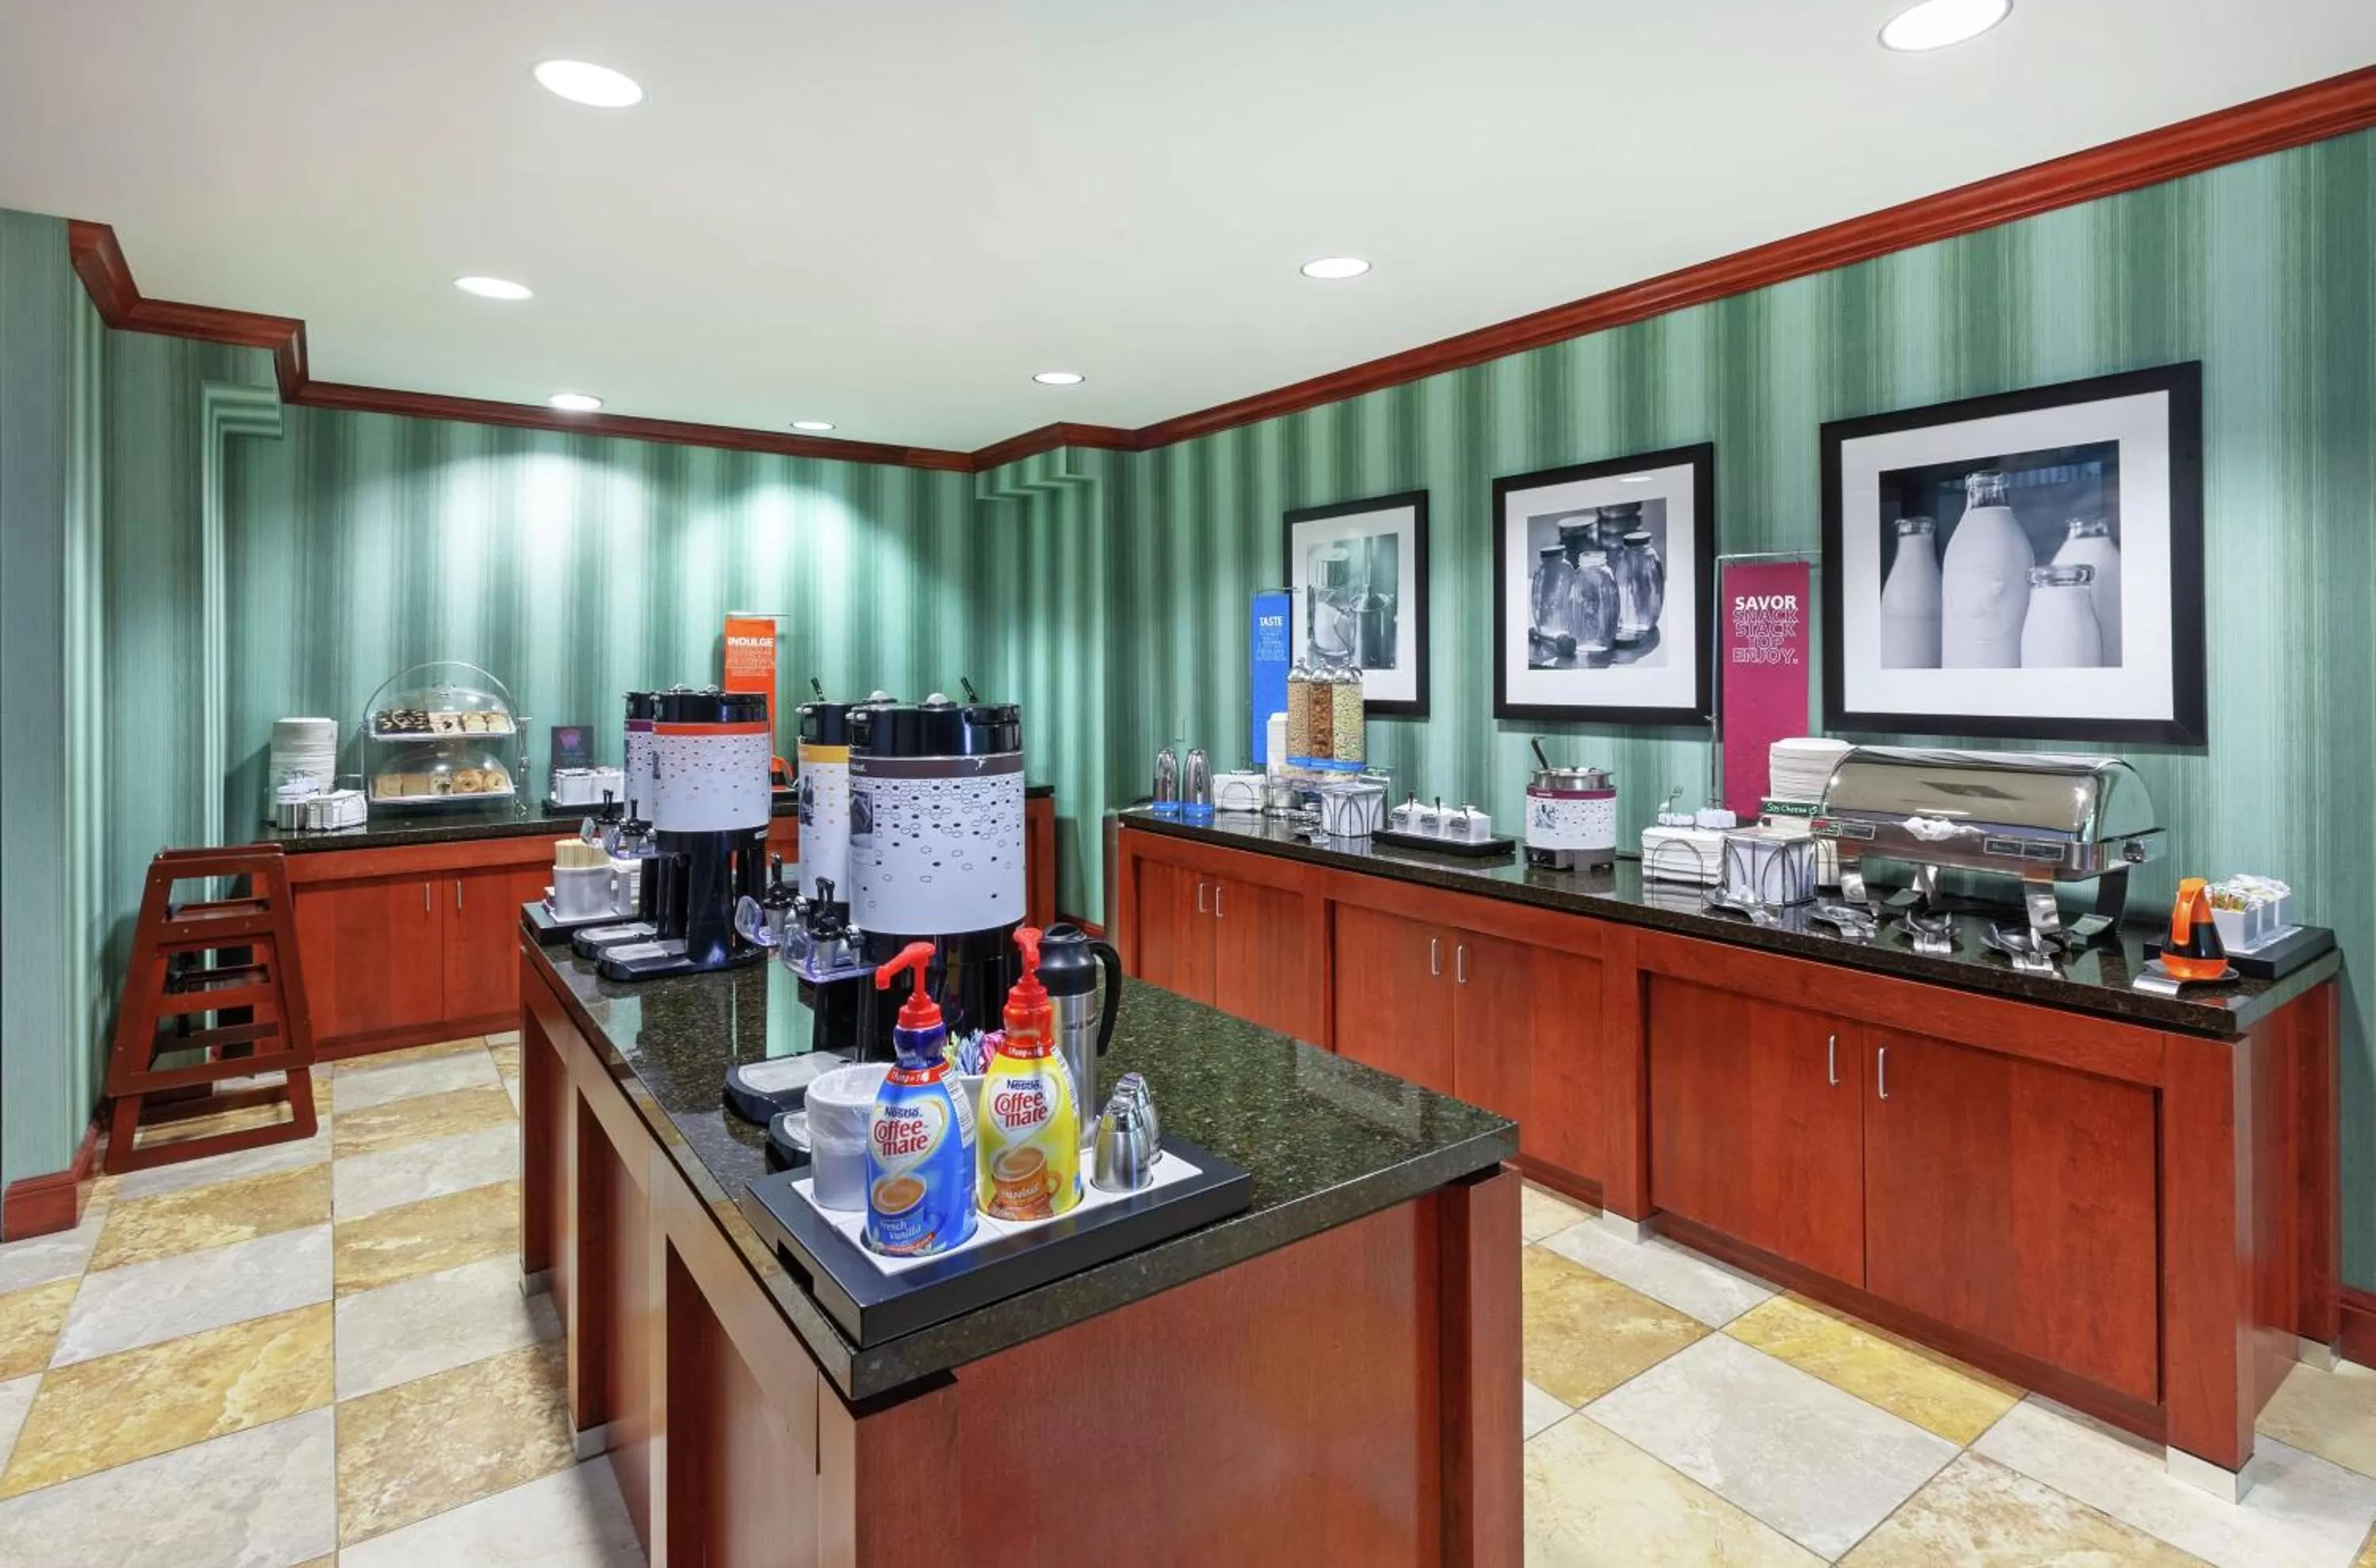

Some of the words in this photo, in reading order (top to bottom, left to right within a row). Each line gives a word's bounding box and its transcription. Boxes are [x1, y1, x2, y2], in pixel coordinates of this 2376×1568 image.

[1735, 595, 1797, 610] SAVOR
[1259, 616, 1283, 626] TASTE
[1733, 608, 1799, 622] SNACK
[1735, 622, 1796, 637] STACK
[728, 637, 774, 646] INDULGE
[1733, 648, 1799, 664] ENJOY.
